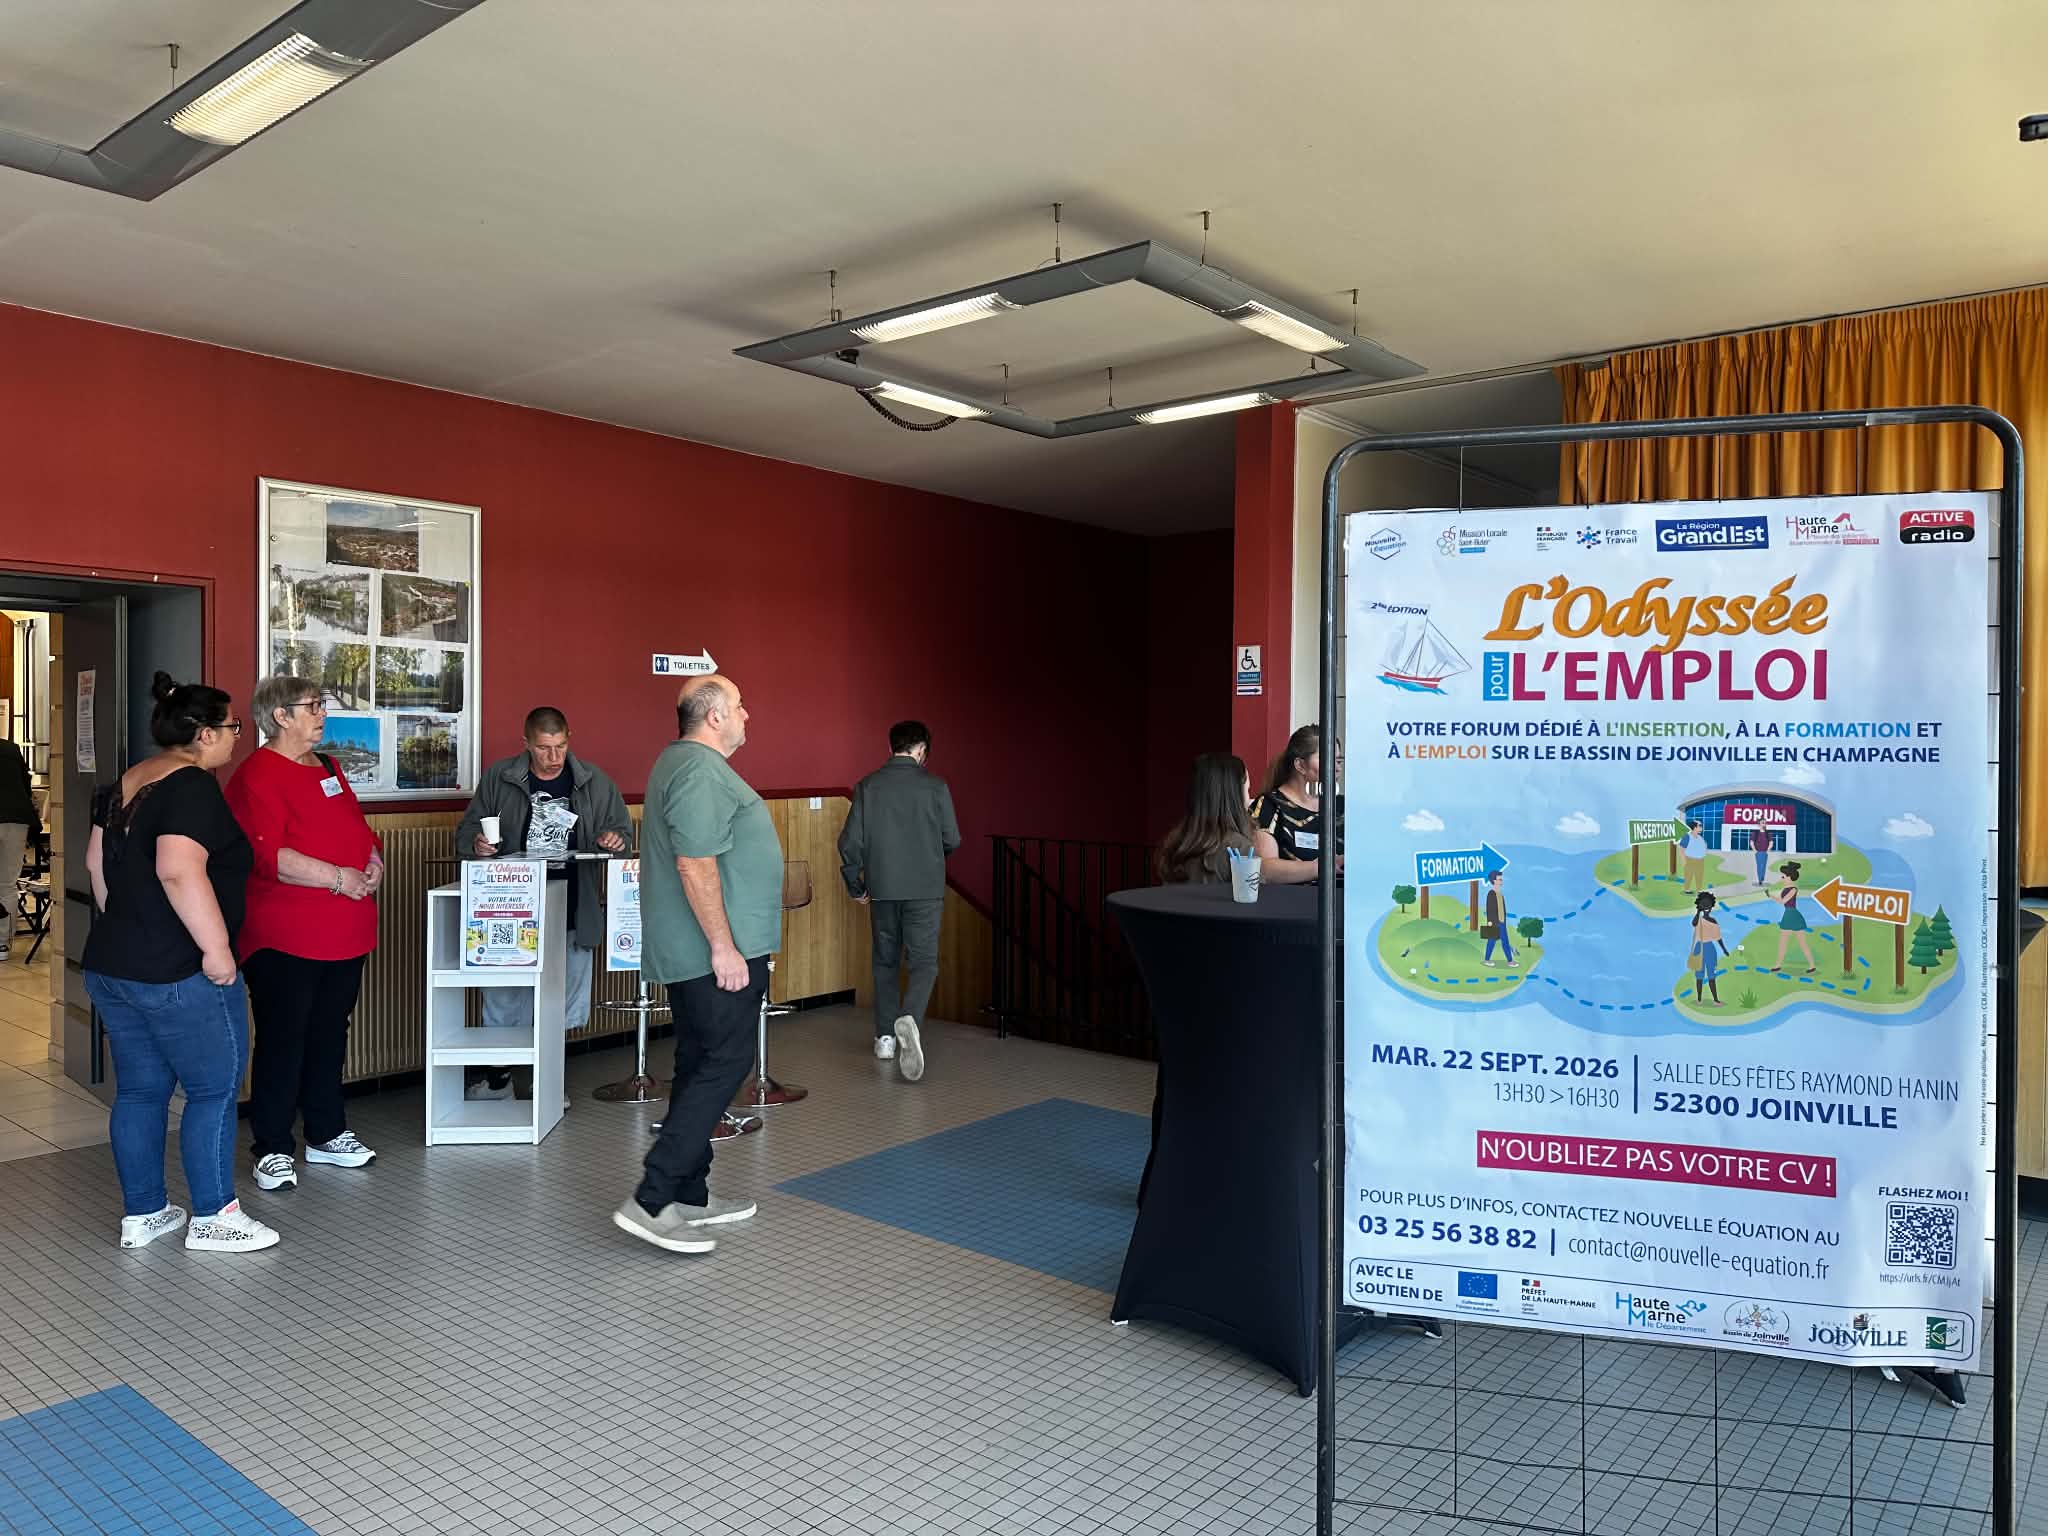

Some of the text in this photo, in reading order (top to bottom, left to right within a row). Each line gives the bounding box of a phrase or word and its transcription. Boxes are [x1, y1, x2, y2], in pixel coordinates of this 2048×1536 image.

[1689, 522, 1720, 531] Région
[1785, 515, 1827, 528] Haute
[1909, 512, 1964, 524] ACTIVE
[1605, 528, 1637, 536] France
[1606, 536, 1637, 544] Travail
[1795, 525, 1839, 539] Marne
[1911, 529, 1964, 542] radio
[1365, 535, 1396, 548] Nouvelle
[1387, 605, 1428, 616] ÉDITION
[1483, 574, 1828, 656] L'Odyssée
[673, 661, 710, 670] TOILETTES
[1490, 649, 1827, 701] pour L'EMPLOI
[1386, 719, 1943, 740] VOTRE FORUM DÉDIÉ À L'INSERTION, À LA FORMATION ET
[1388, 742, 1940, 763] À L'EMPLOI SUR LE BASSIN DE JOINVILLE EN CHAMPAGNE
[1733, 807, 1787, 824] FORUM
[1633, 822, 1677, 841] INSERTION
[1421, 855, 1484, 879] FORMATION
[491, 874, 533, 883] L'EMPLOI
[1837, 890, 1903, 917] EMPLOI
[1372, 1044, 1619, 1078] MAR. 22 SEPT. 2026
[1653, 1062, 1959, 1102] SALLE DES FÊTES RAYMOND HANIN
[1494, 1082, 1545, 1103] 13H30
[1568, 1087, 1620, 1109] 16H30
[1653, 1091, 1898, 1129] 52300 JOINVILLE
[1481, 1137, 1832, 1187] N'OUBLIEZ PAS VOTRE CV !
[1879, 1186, 1969, 1202] FLASHEZ MOI !
[1360, 1188, 1840, 1247] POUR PLUS D'INFOS, CONTACTEZ NOUVELLE ÉQUATION AU
[1358, 1215, 1537, 1249] 03 25 56 38 82
[1568, 1237, 1829, 1280] contact@nouvelle-equation.fr
[1356, 1263, 1414, 1280] AVEC LE
[1355, 1282, 1443, 1302] SOUTIEN DE
[1521, 1288, 1546, 1296] PRÉFET
[1616, 1291, 1670, 1311] Haute
[1544, 1297, 1597, 1309] HAUTE-MARNE
[1628, 1310, 1686, 1327] Marne
[1752, 1331, 1790, 1342] Joinville
[1808, 1324, 1908, 1347] JOINVILLE
